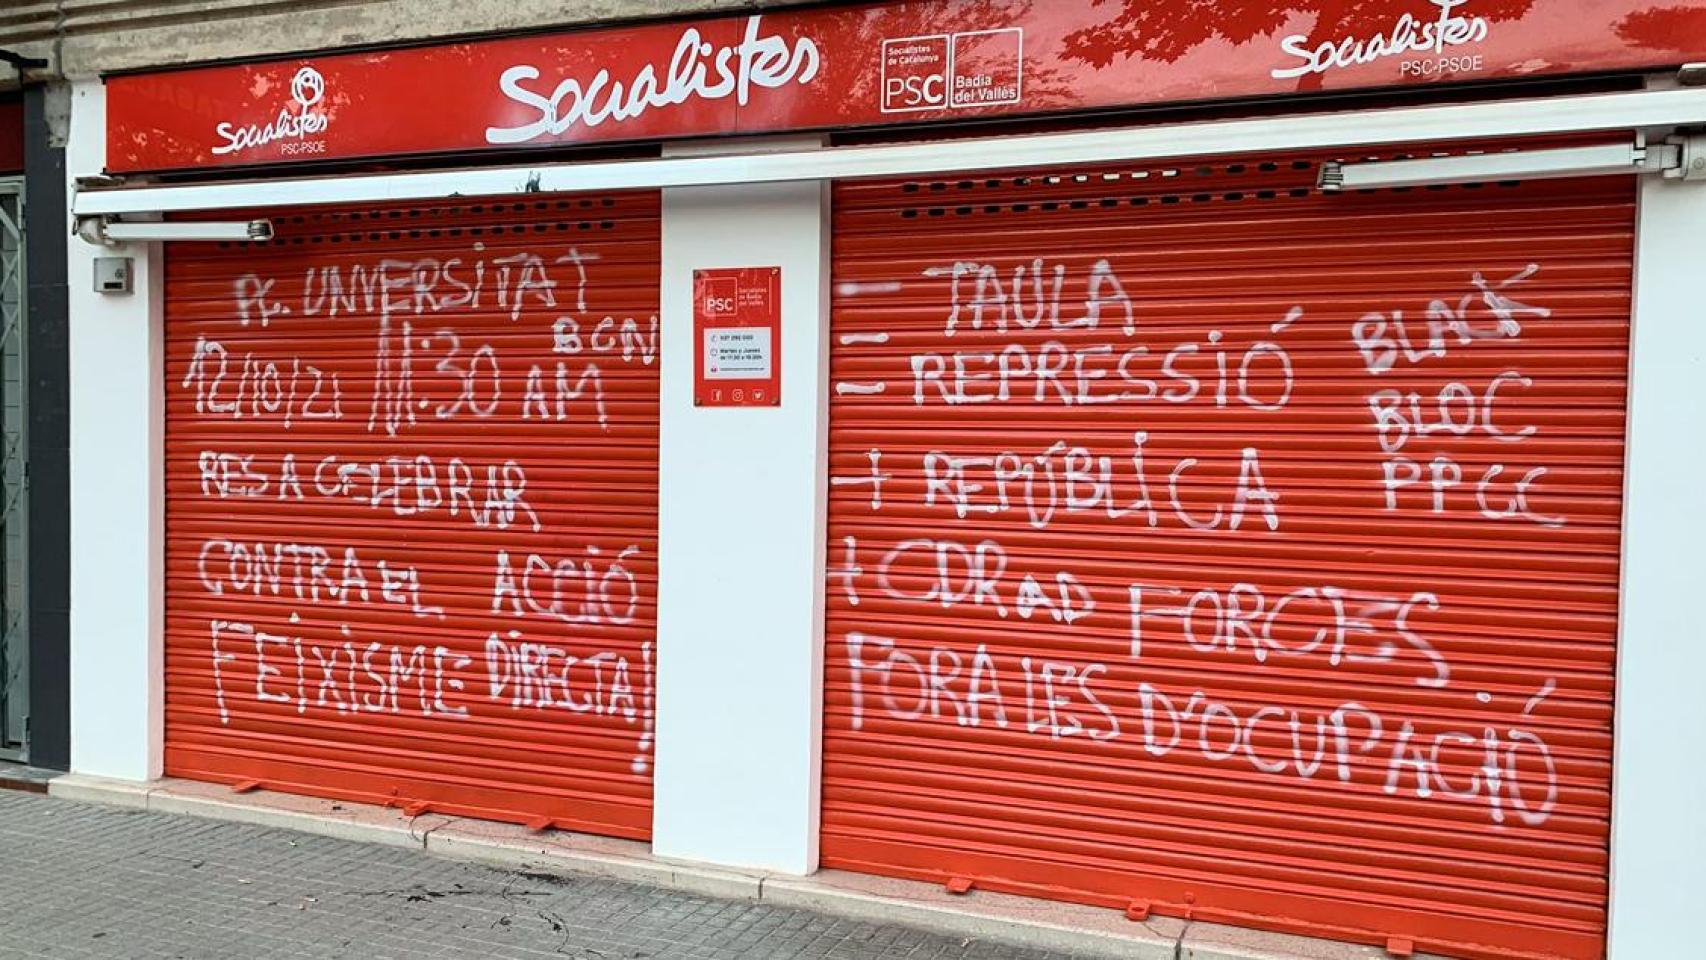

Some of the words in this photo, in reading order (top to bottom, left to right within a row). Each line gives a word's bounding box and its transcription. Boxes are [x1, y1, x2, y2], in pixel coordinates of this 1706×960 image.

[485, 15, 820, 144] Socialistes
[955, 74, 992, 88] Badia
[1271, 12, 1488, 78] Socialistes
[1400, 56, 1483, 76] PSC-PSOE
[886, 74, 944, 107] PSC
[955, 88, 974, 102] del
[211, 108, 328, 154] Socialistes
[281, 140, 327, 155] PSC-PSOE
[706, 298, 734, 312] PSC
[922, 258, 1136, 337] TAULA
[1351, 262, 1552, 375] BLACK
[552, 317, 659, 365] BCN
[910, 306, 1304, 411] REPRESSIÓ
[182, 333, 343, 429] 12/10/21
[522, 361, 609, 431] AM
[1367, 370, 1537, 453] BLOC
[199, 450, 269, 499] RES
[278, 453, 304, 500] A
[314, 454, 542, 533] CELEBRAR
[199, 539, 369, 605] CONTRA
[877, 538, 1009, 619] CDR
[1129, 583, 1451, 688] FORCES
[845, 632, 1009, 731] FORA
[1020, 655, 1121, 740] LES
